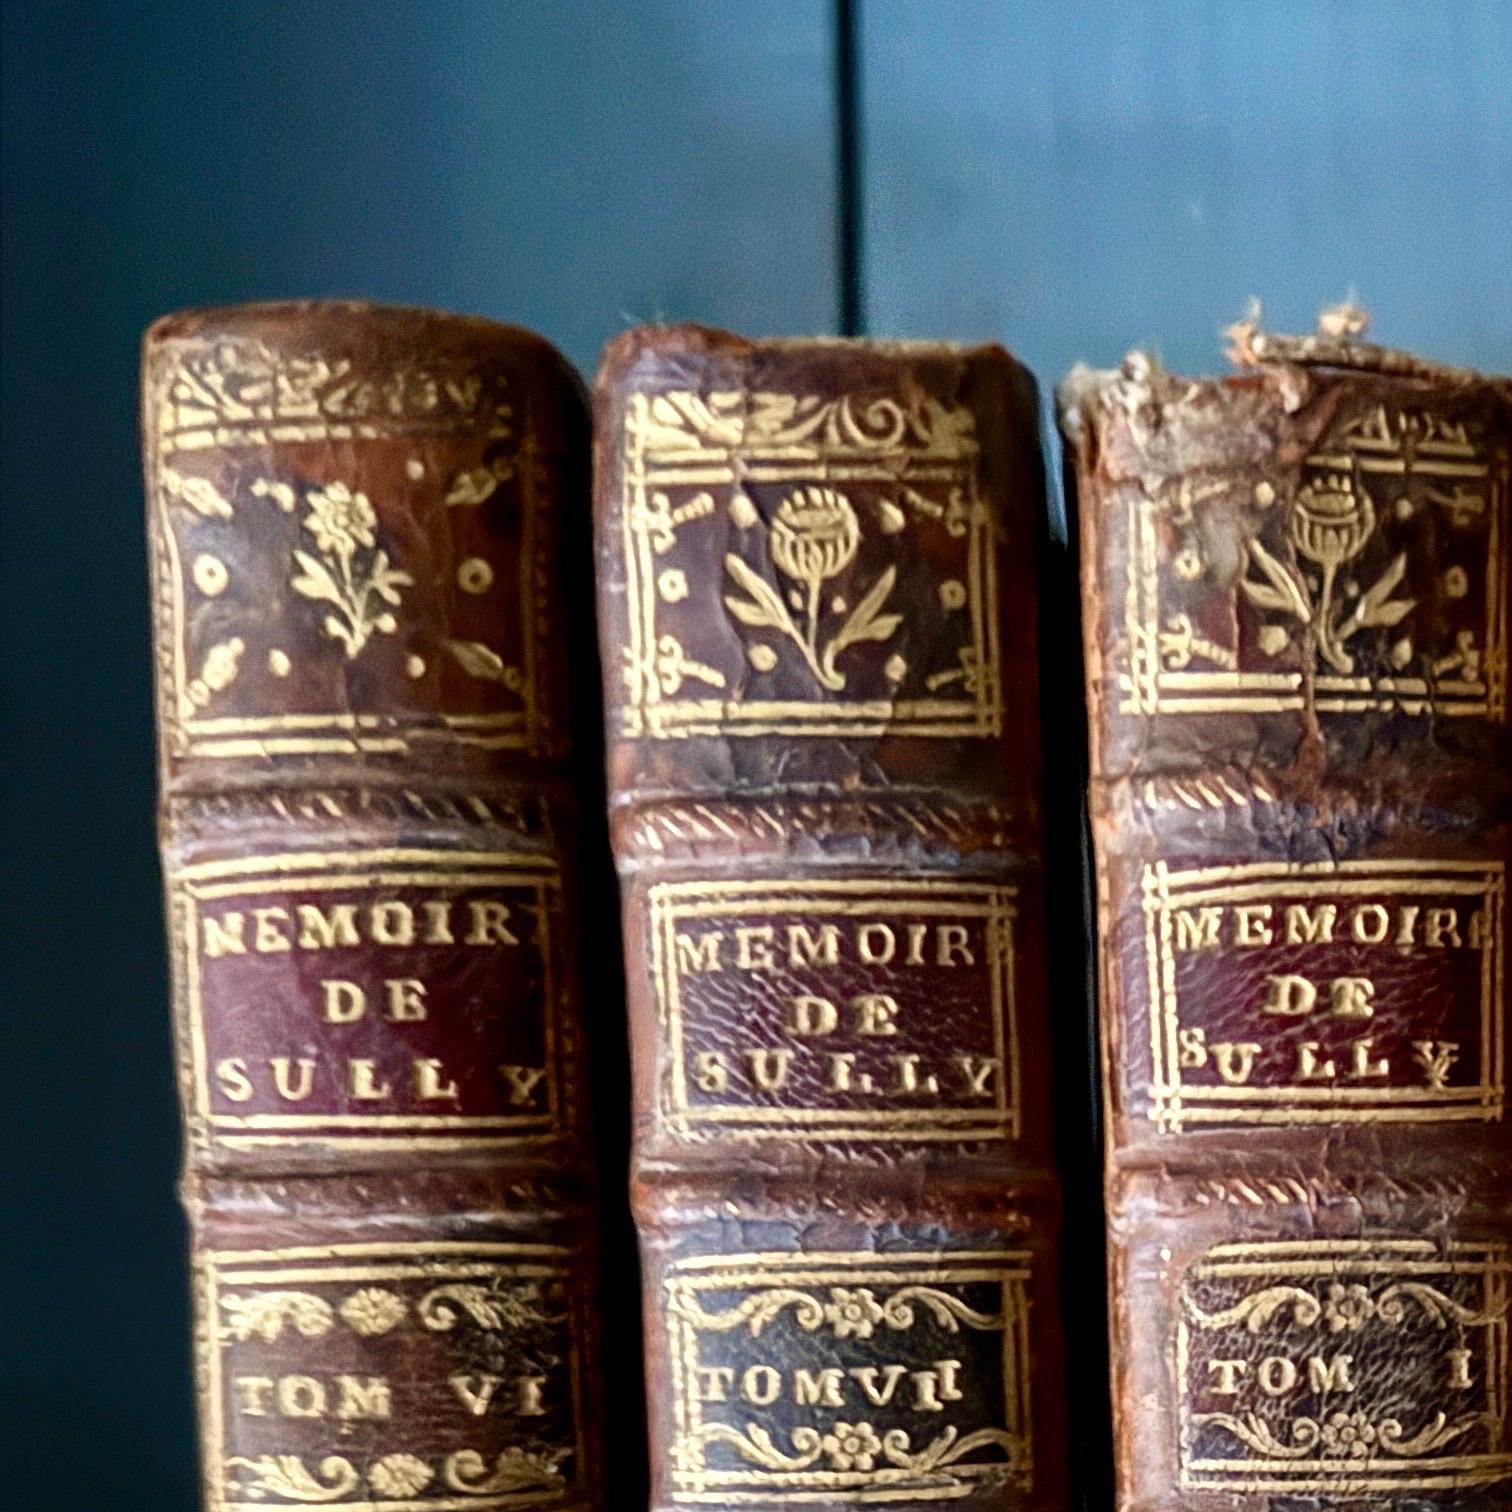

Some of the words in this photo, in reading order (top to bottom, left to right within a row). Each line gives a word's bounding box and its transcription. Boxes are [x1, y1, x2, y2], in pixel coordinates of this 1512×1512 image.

[676, 922, 976, 974] MEMOIR
[321, 979, 429, 1024] DE
[784, 993, 899, 1036] DE
[695, 1047, 1000, 1098] SULLY
[1178, 1026, 1460, 1089] SULLY
[215, 1057, 546, 1106] SULLY
[447, 1374, 547, 1417] VI
[1207, 1354, 1355, 1396] TOM
